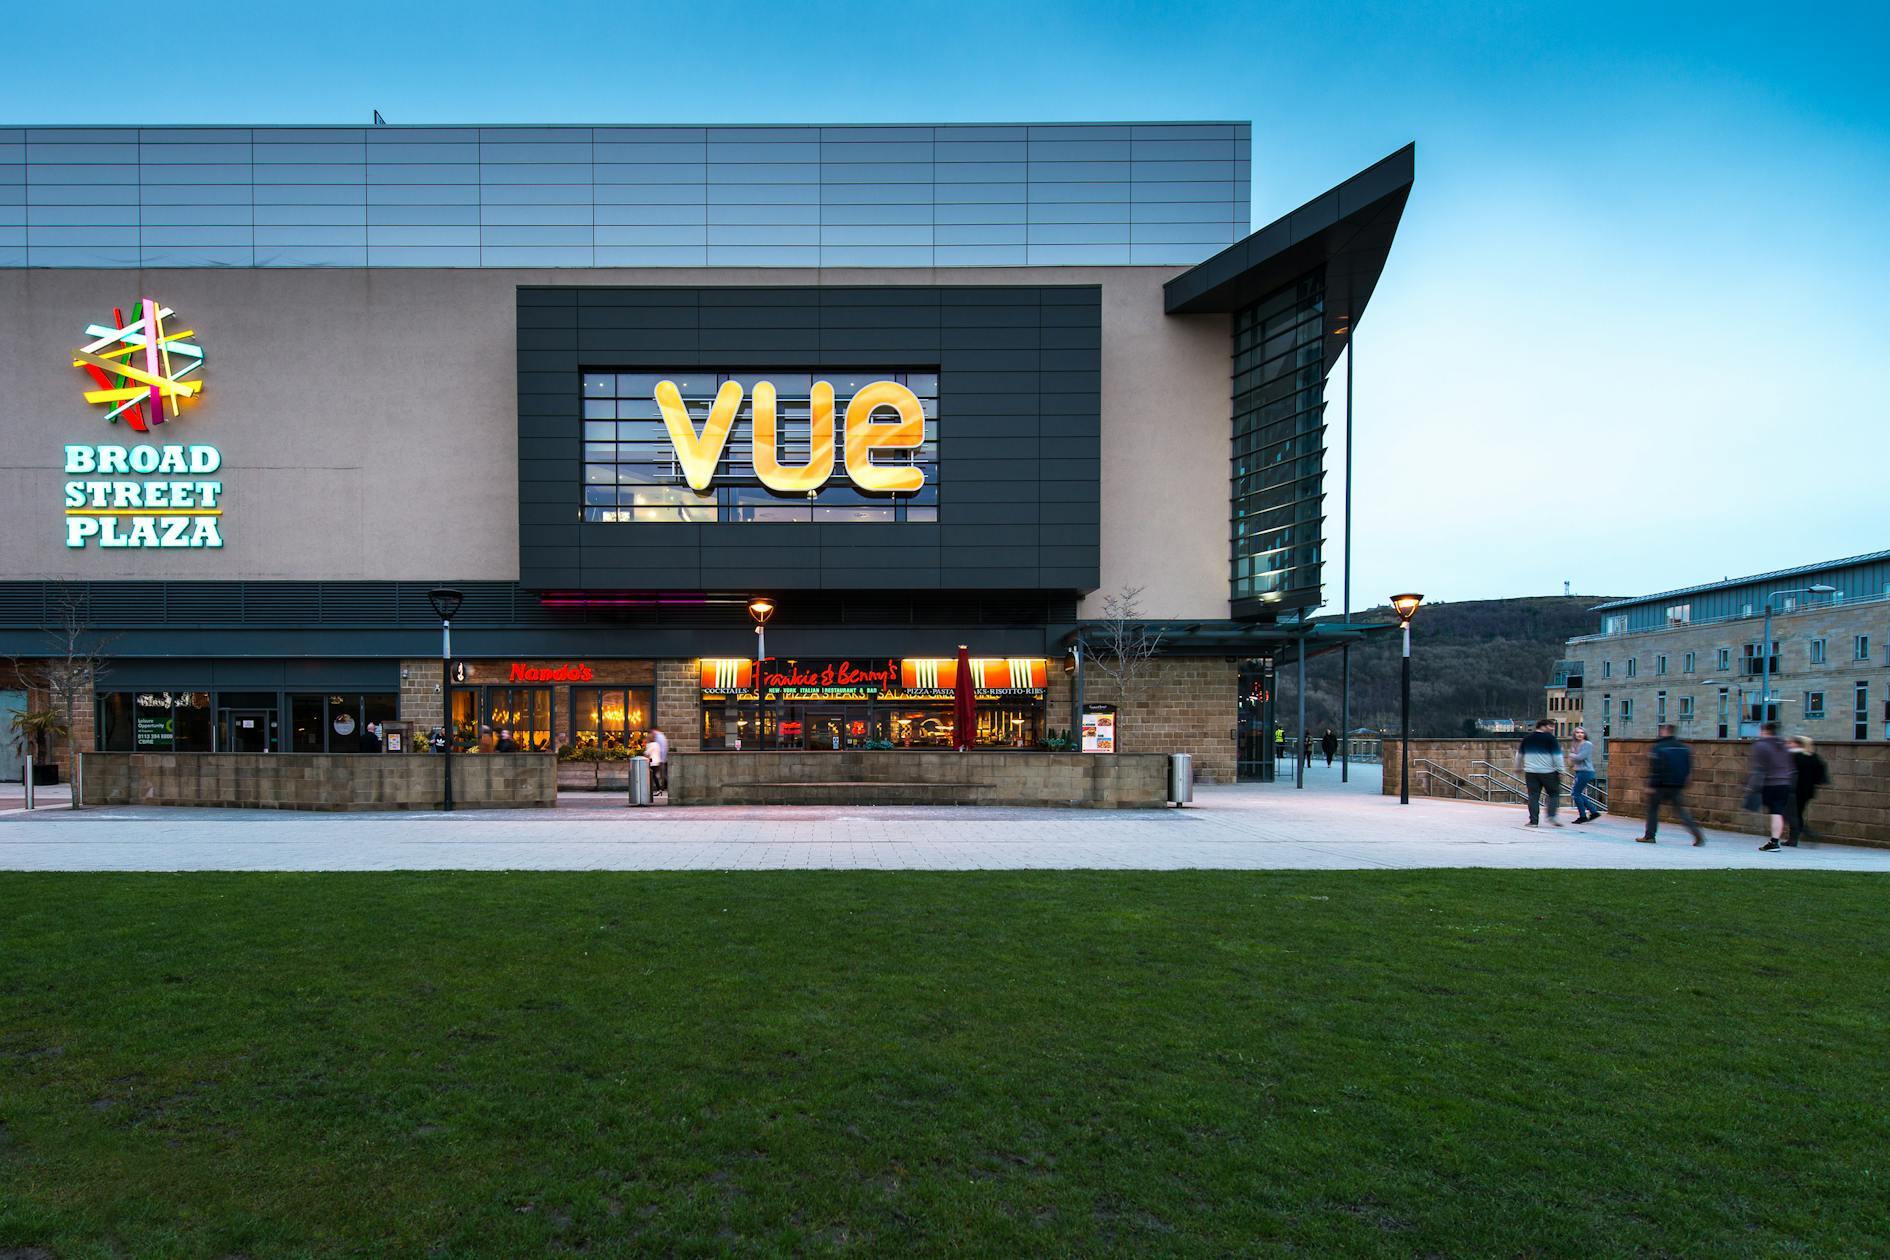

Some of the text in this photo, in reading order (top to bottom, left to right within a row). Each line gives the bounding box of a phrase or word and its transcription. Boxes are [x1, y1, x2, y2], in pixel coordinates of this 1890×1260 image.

[65, 445, 221, 474] BROAD
[65, 481, 222, 508] STREET
[66, 517, 223, 547] PLAZA
[509, 663, 593, 682] Nando's
[751, 657, 818, 691] Frankie
[837, 659, 898, 691] Benny's
